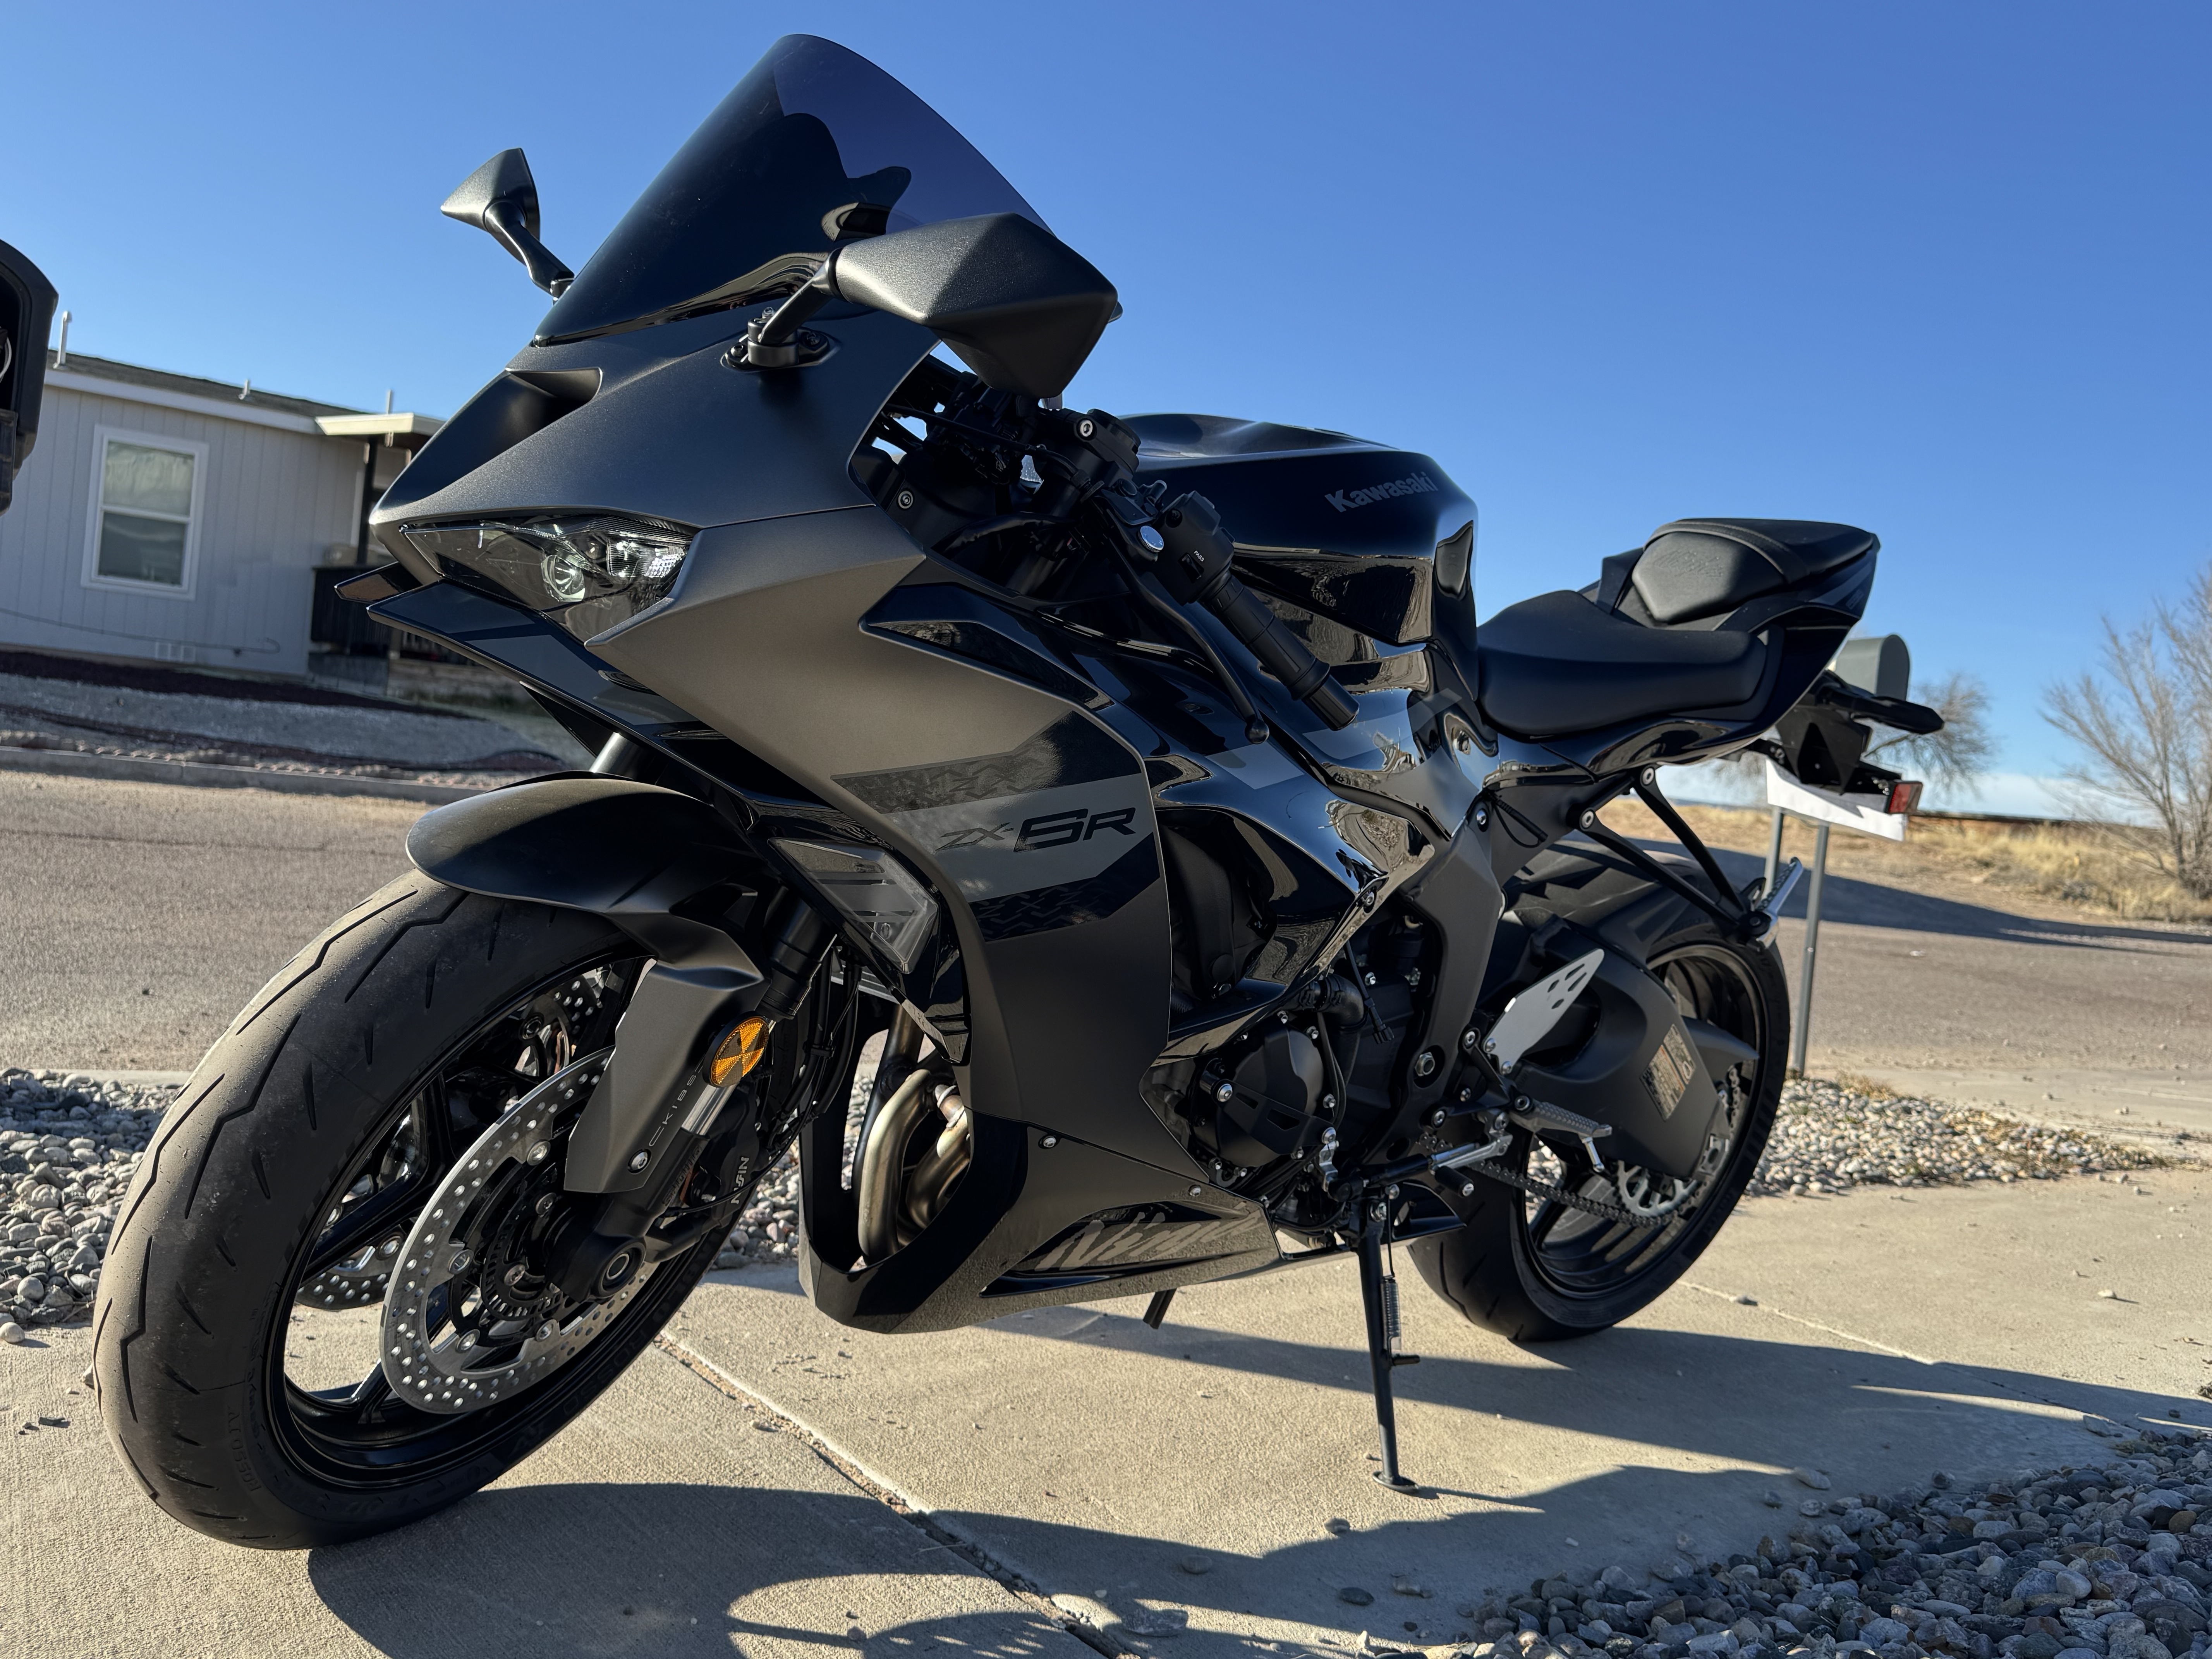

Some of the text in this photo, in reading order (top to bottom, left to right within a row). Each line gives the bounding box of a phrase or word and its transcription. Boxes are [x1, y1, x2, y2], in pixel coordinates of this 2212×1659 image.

[1324, 471, 1439, 513] Kawasaki
[1193, 550, 1205, 562] PASS
[935, 807, 1136, 854] ZX-6R
[650, 1231, 723, 1324] IABLO
[231, 1439, 262, 1492] ROSSO
